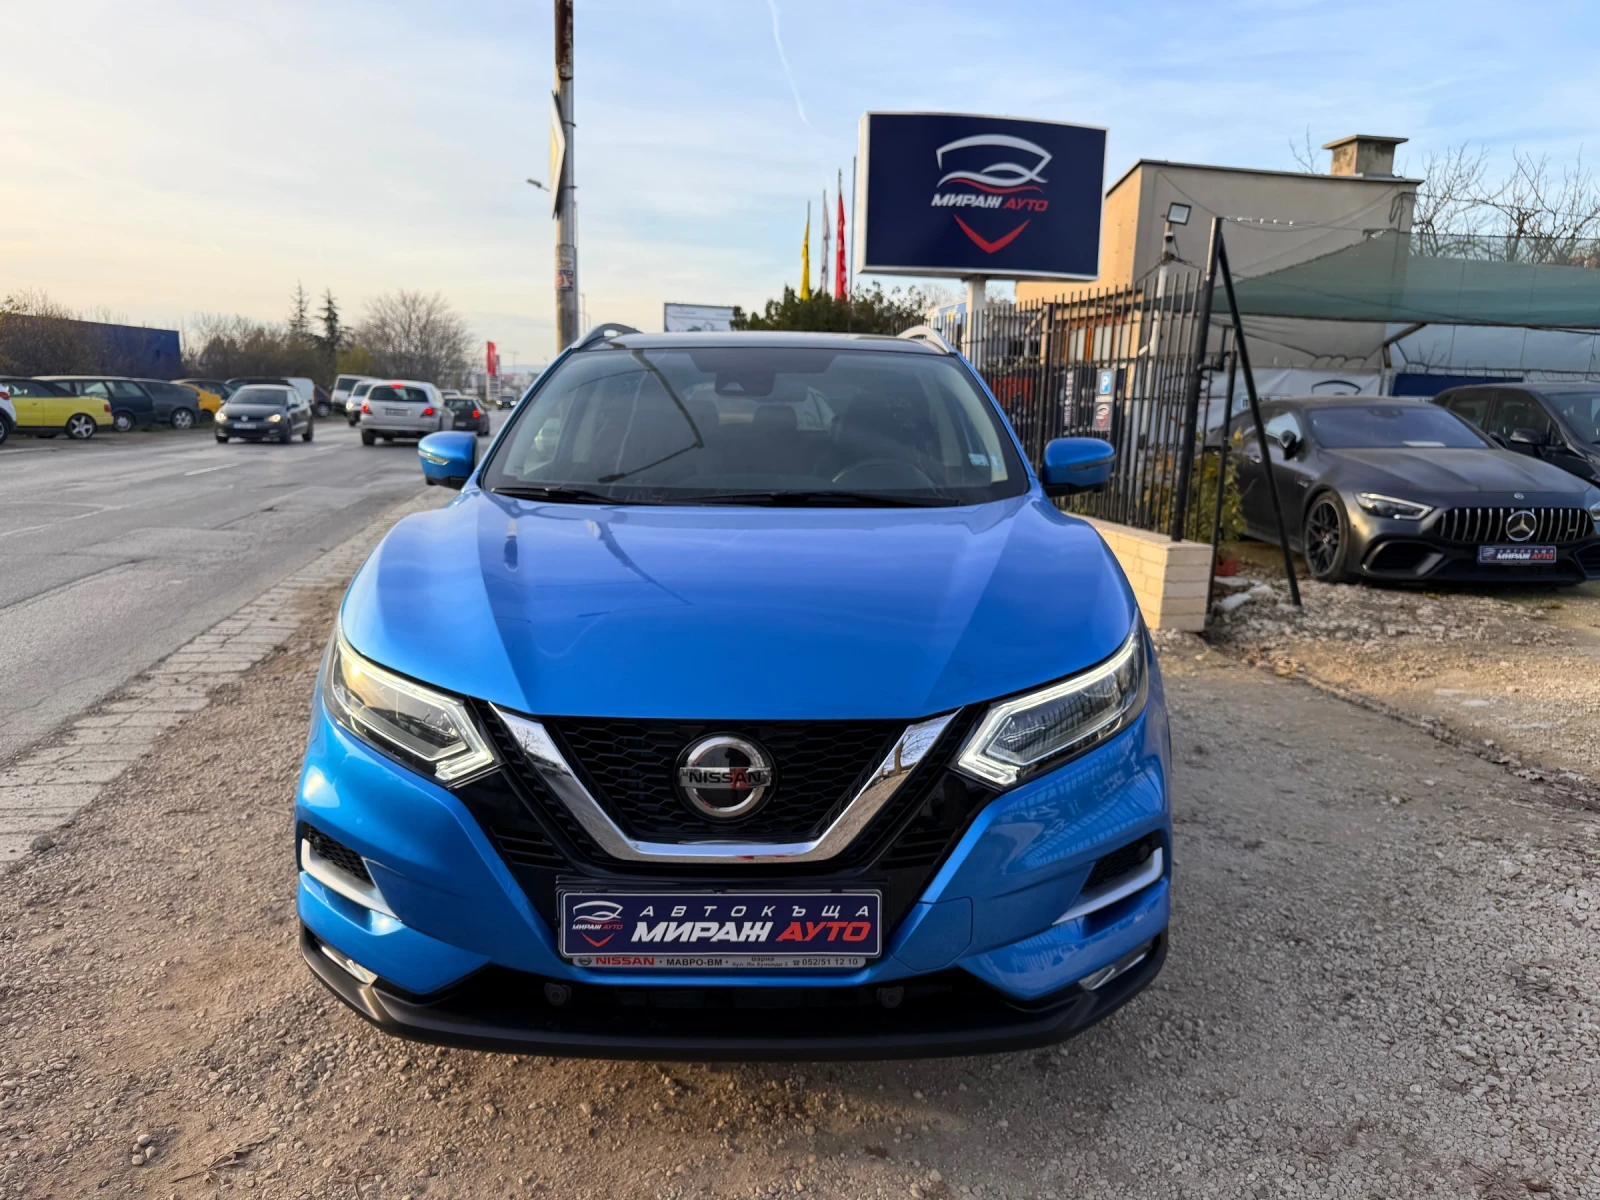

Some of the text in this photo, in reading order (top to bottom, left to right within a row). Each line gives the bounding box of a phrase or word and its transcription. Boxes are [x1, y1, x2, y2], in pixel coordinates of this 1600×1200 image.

[931, 193, 1049, 212] МИРАЖ АУТО
[689, 772, 760, 784] NISSAN
[639, 905, 869, 919] АВТОКЪЩА
[631, 921, 871, 942] МИРАЖ АУТО
[595, 956, 655, 966] NISSAN
[666, 957, 723, 966] МАВРО-ВМ
[802, 958, 858, 966] 052/51 12 10
